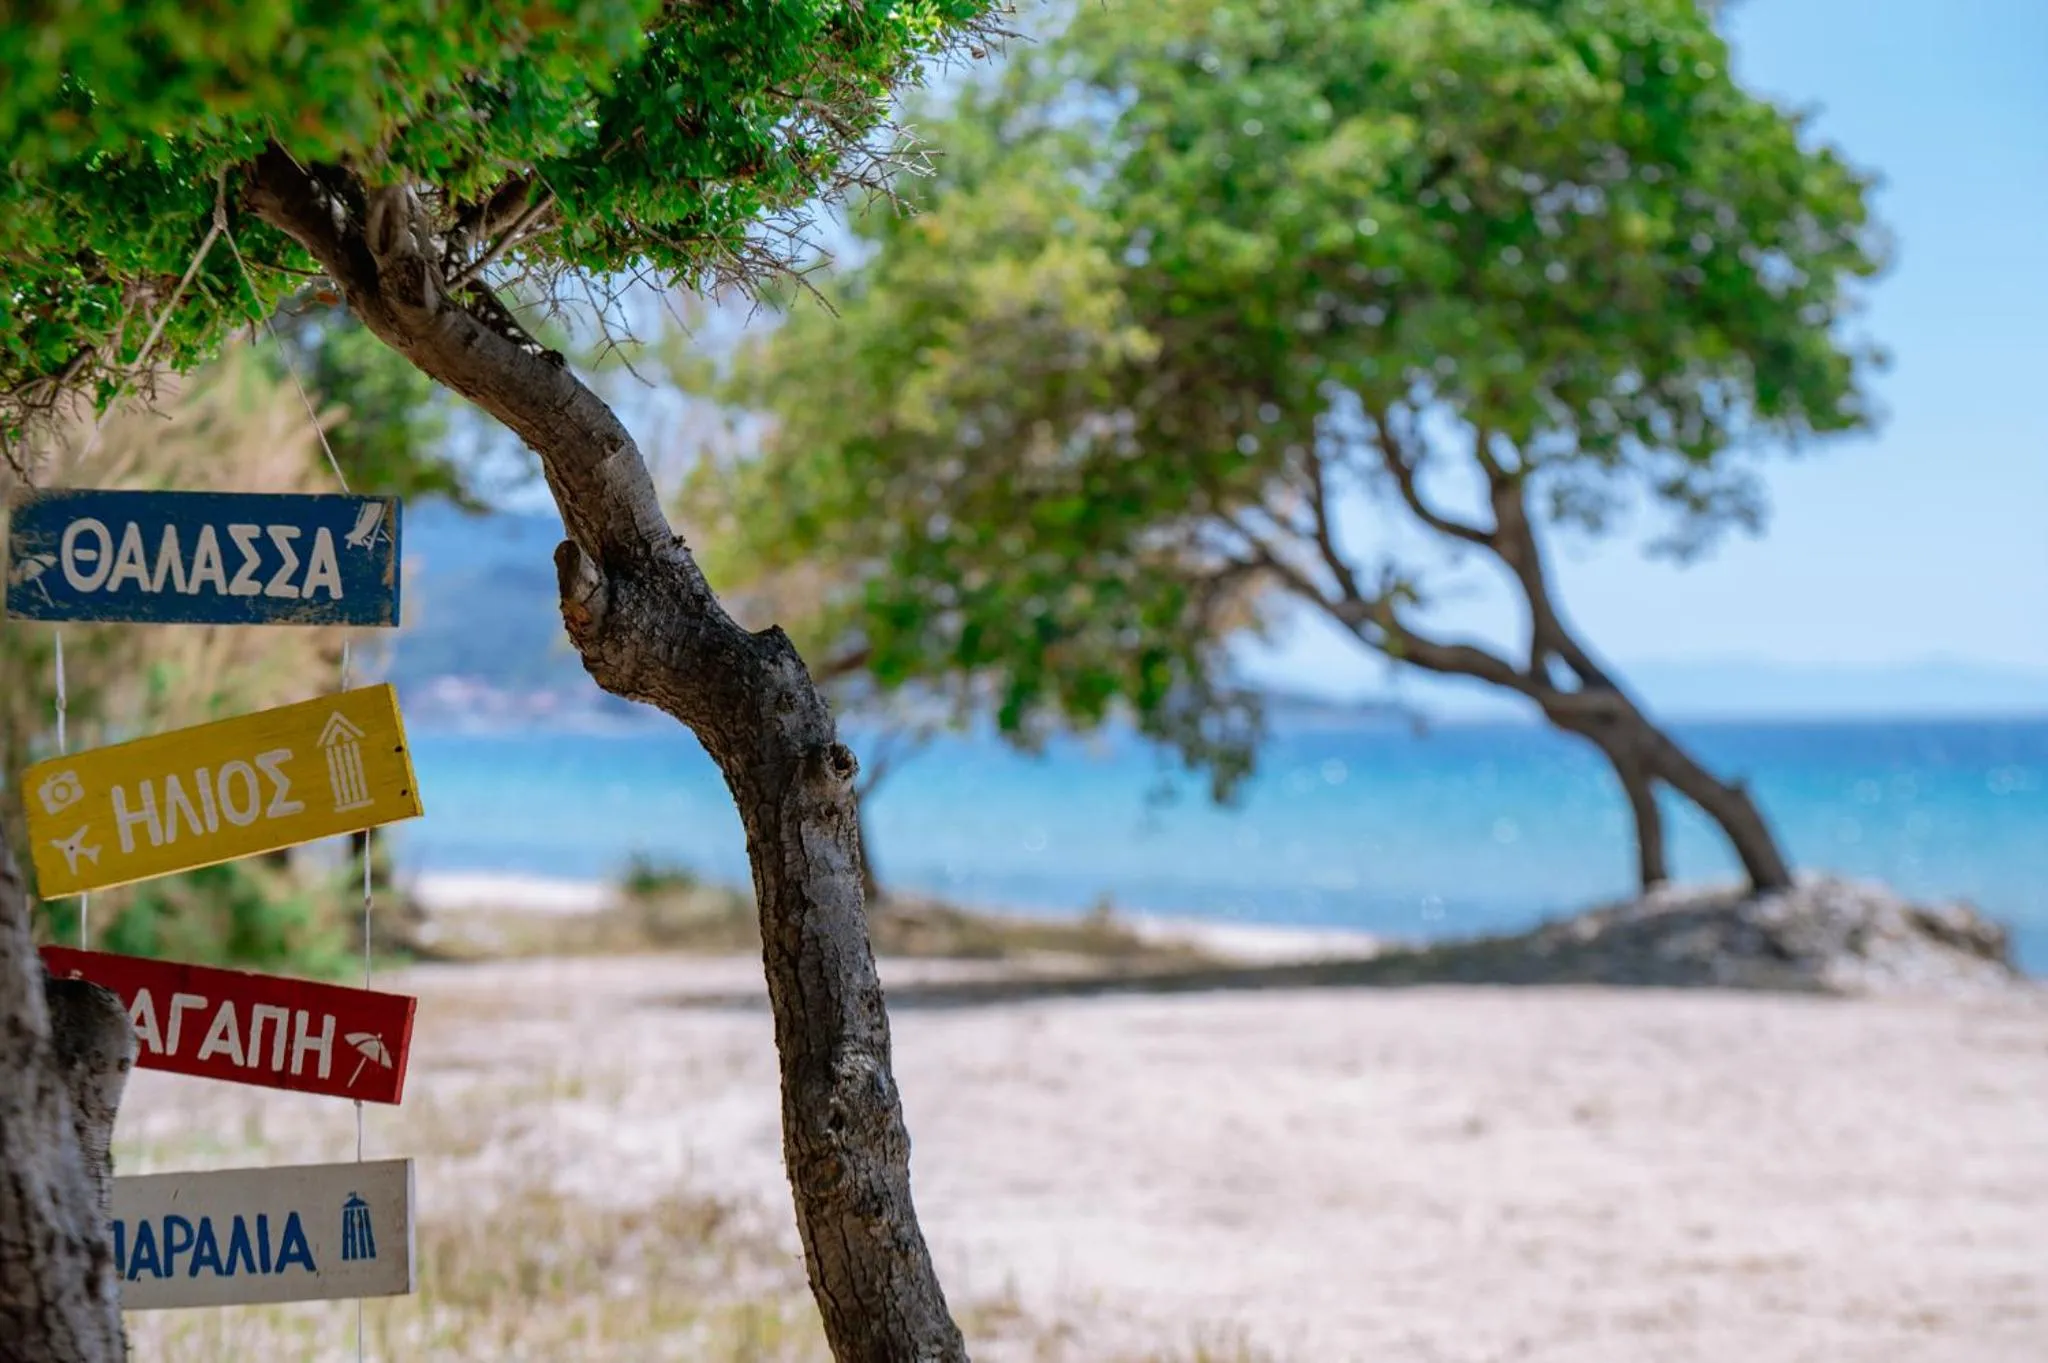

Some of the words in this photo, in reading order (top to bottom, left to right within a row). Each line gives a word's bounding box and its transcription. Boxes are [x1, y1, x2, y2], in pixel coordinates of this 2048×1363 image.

[60, 517, 343, 600] ΘΑΛΑΣΣΑ
[110, 748, 305, 854] ΗΛΙΟΣ
[128, 988, 336, 1080] ΑΓΑΠΗ
